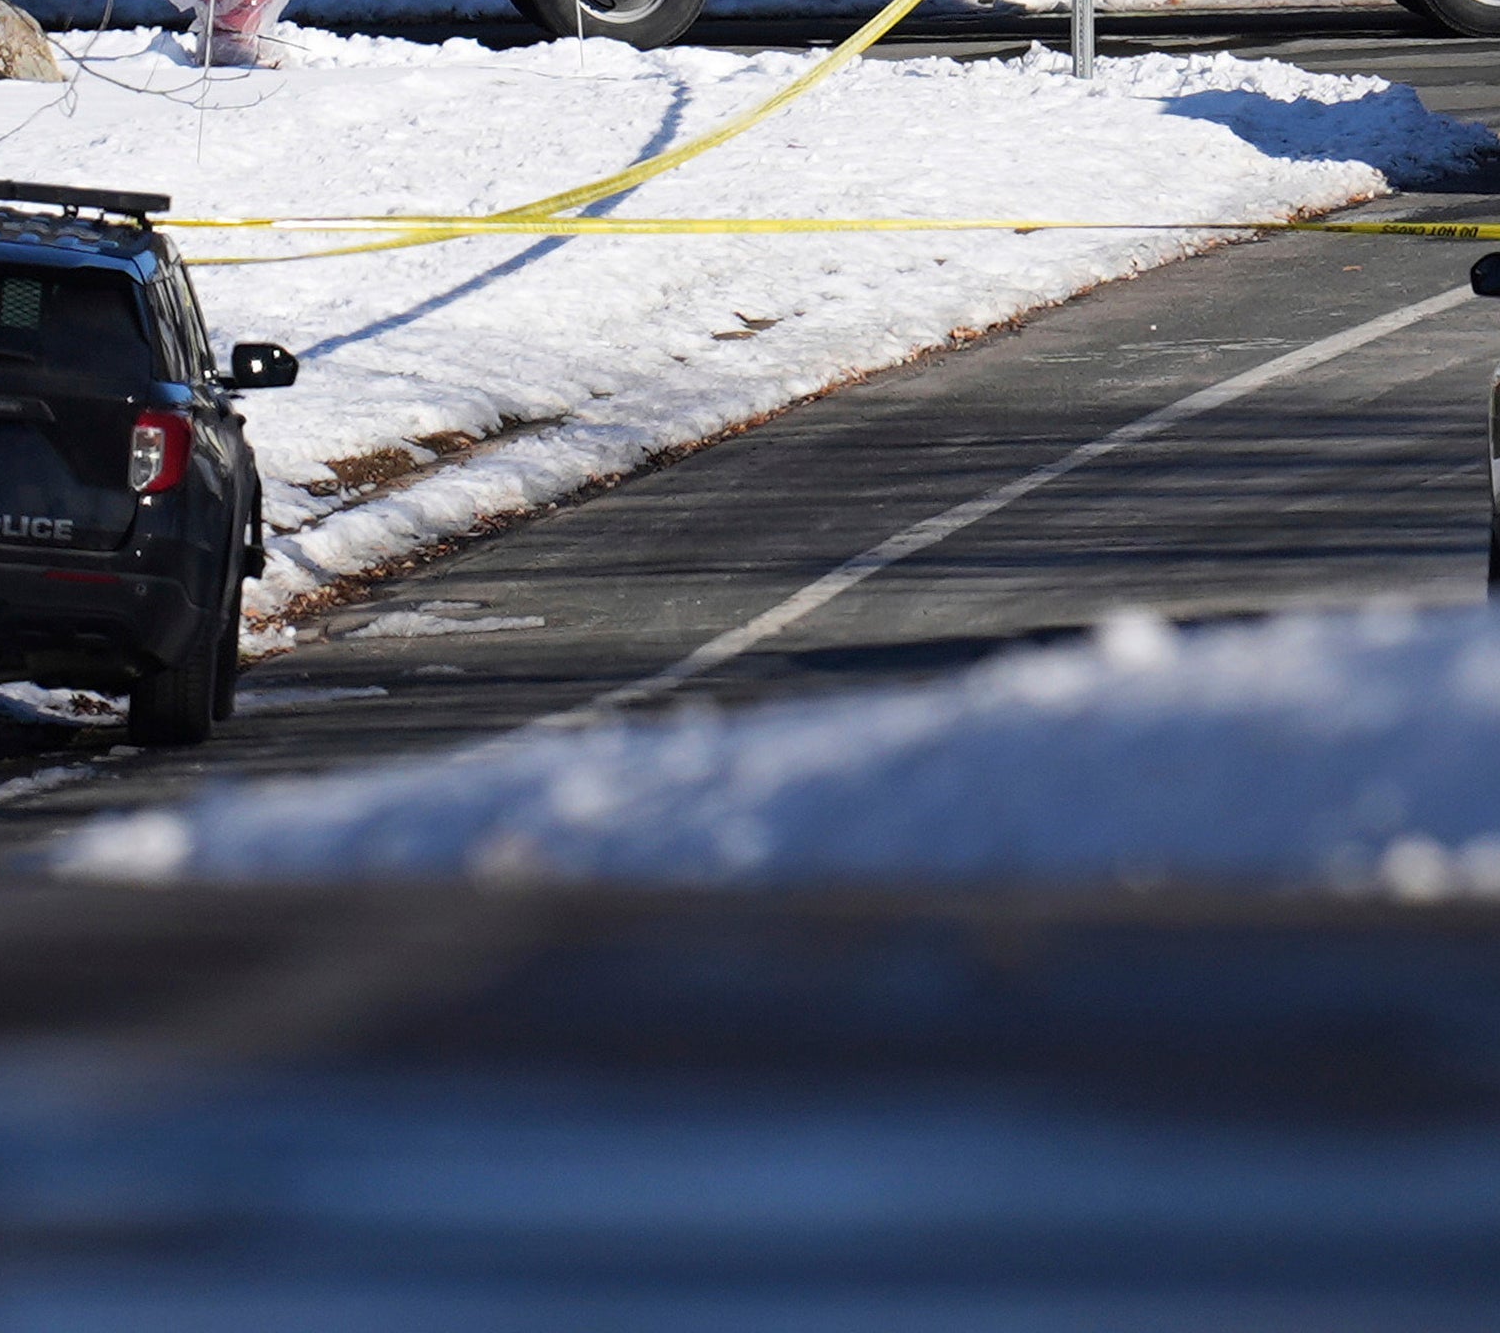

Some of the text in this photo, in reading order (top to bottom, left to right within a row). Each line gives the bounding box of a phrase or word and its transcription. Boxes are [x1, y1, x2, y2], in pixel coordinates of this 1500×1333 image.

[1382, 224, 1428, 236] CROSS
[1429, 225, 1457, 238] NOT
[1459, 226, 1480, 239] DO
